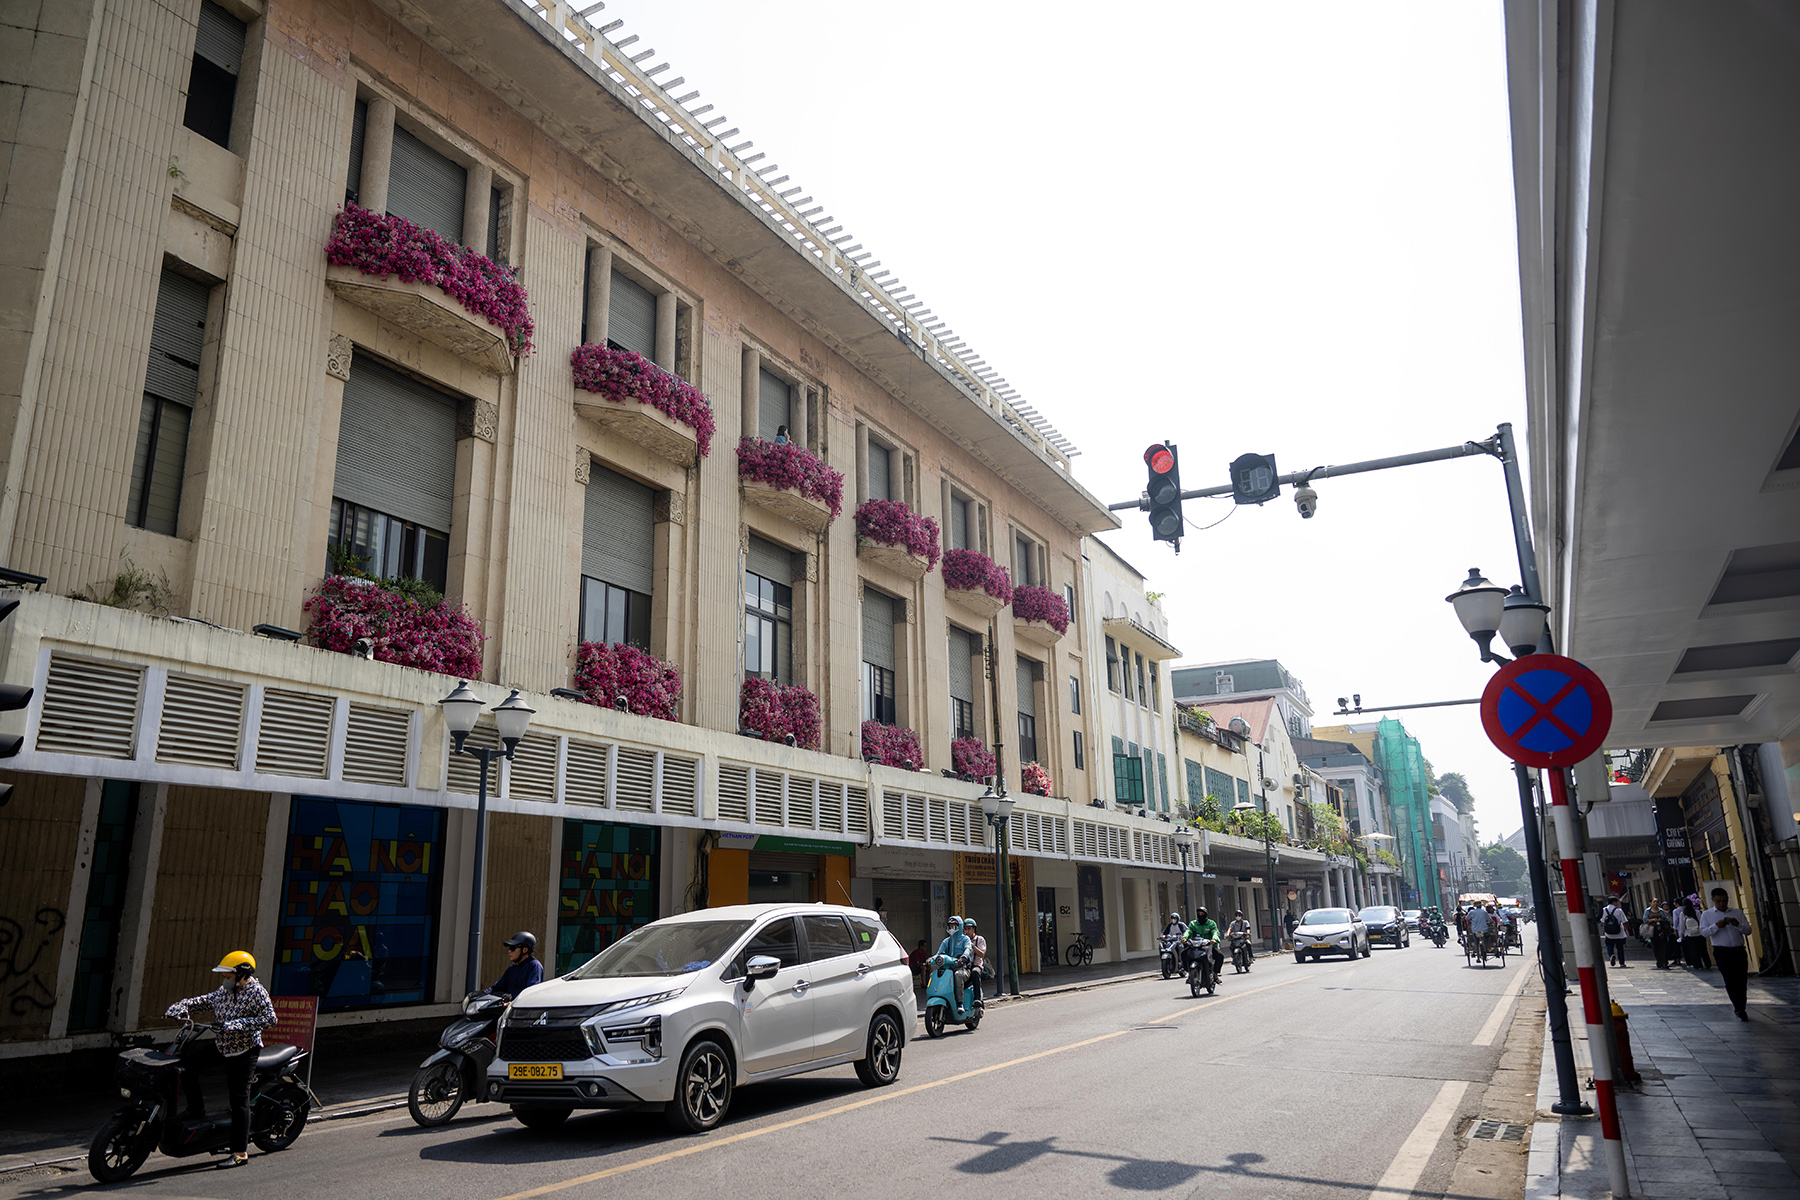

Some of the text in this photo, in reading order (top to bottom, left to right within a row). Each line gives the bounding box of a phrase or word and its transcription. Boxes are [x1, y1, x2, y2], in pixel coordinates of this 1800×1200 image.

[369, 832, 431, 883] NỘI
[611, 847, 651, 888] NỘI
[561, 878, 634, 918] SÁNG
[1059, 905, 1071, 915] 62
[513, 1066, 558, 1077] 29E-082.75
